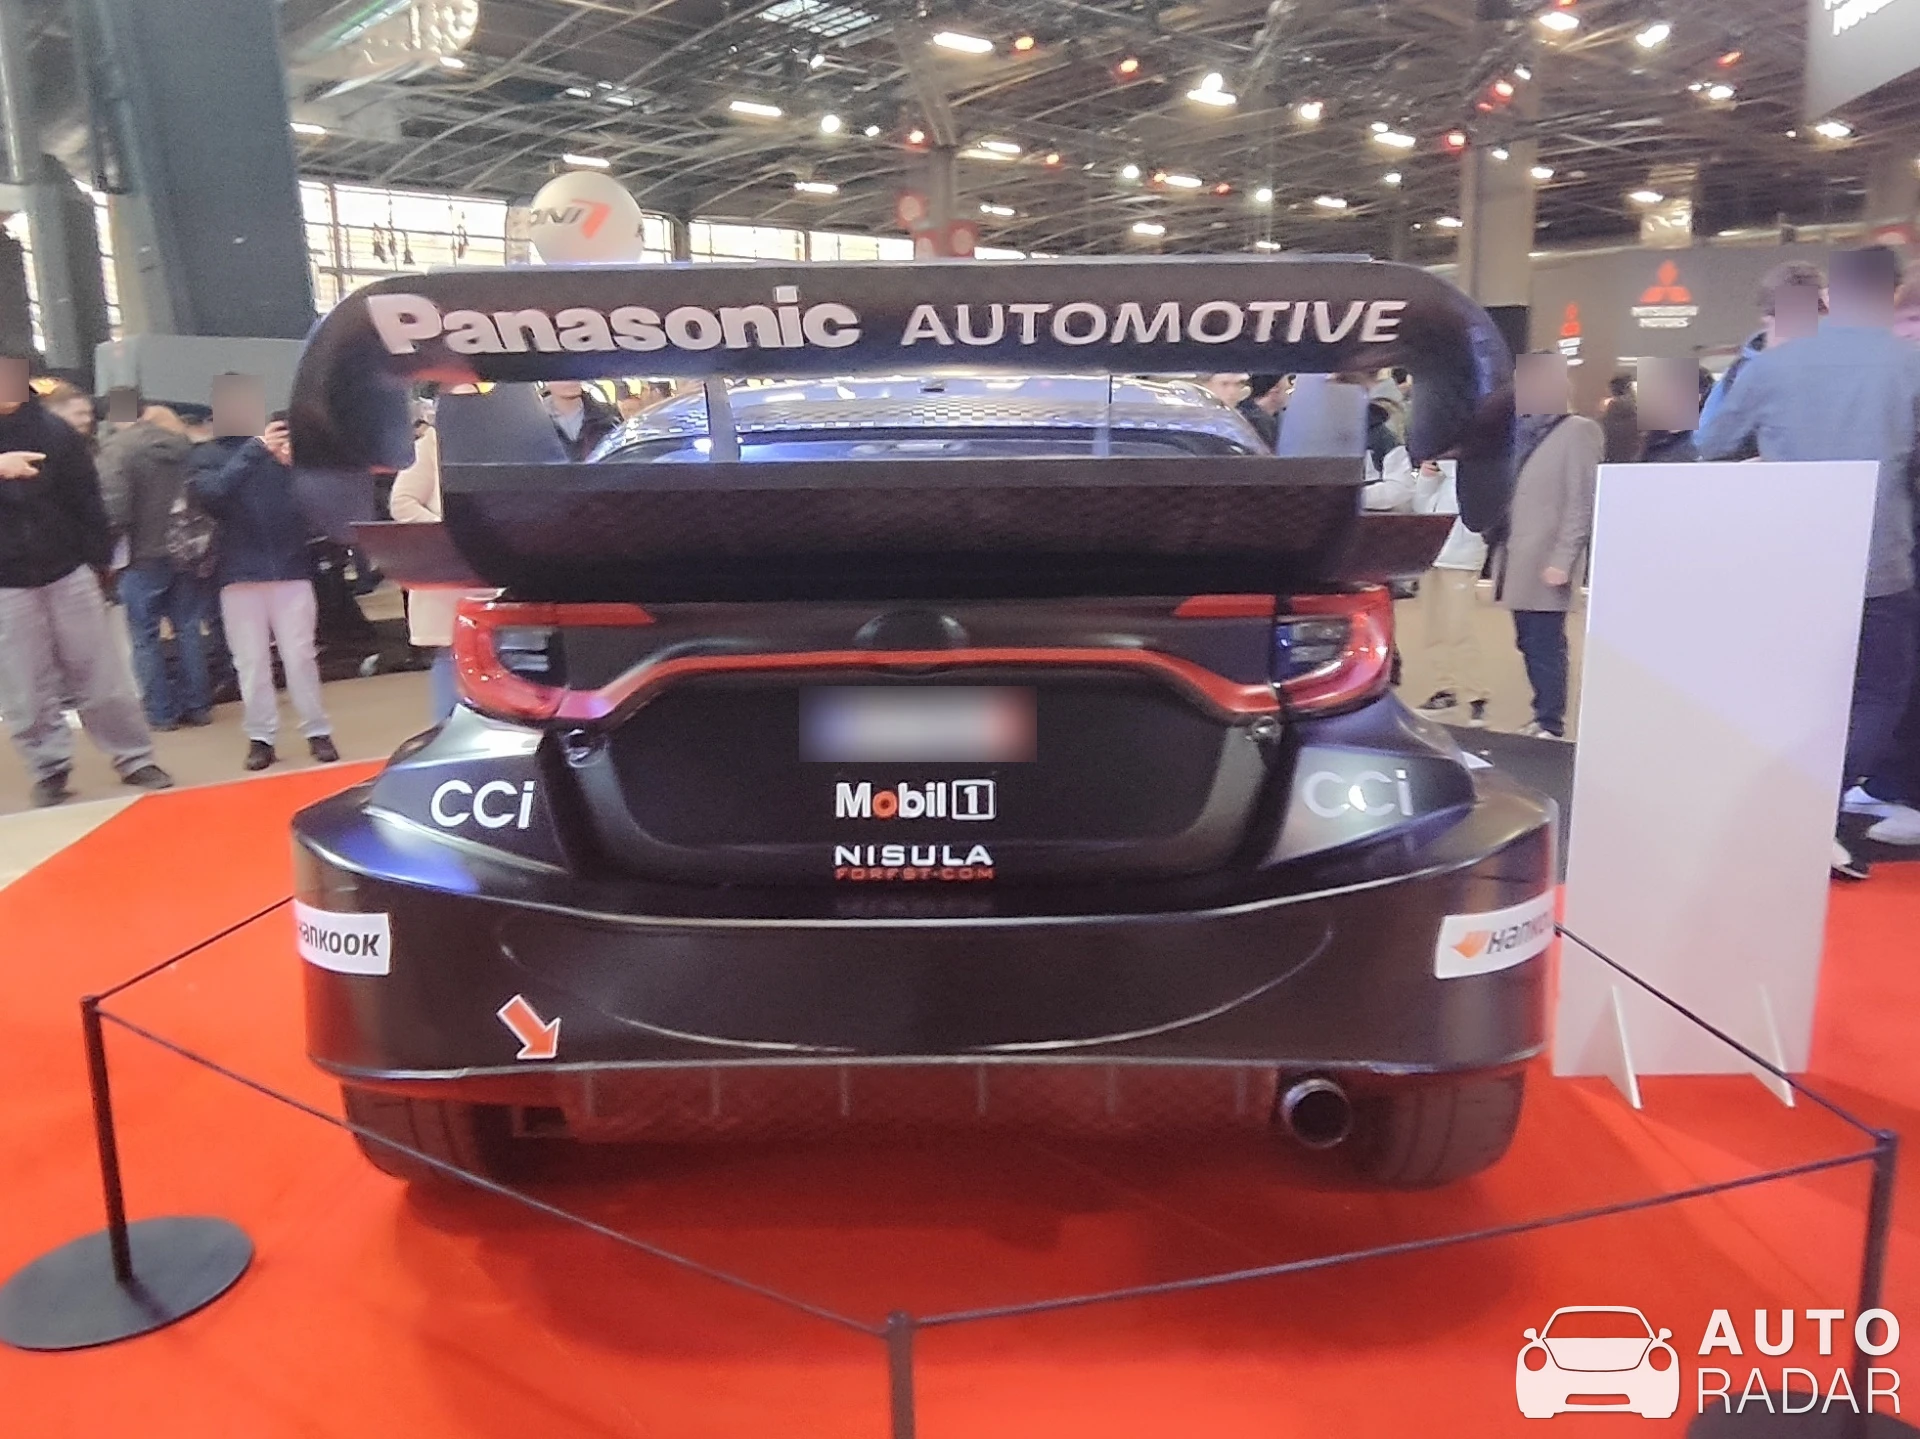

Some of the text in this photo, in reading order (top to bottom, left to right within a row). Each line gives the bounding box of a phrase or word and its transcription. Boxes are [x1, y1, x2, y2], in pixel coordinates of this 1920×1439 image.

[367, 285, 1407, 354] Panasonic AUTOMOTIVE
[430, 779, 536, 830] CCi
[835, 782, 947, 819] Mobil
[1303, 768, 1414, 818] CCi
[835, 844, 994, 867] NISULA
